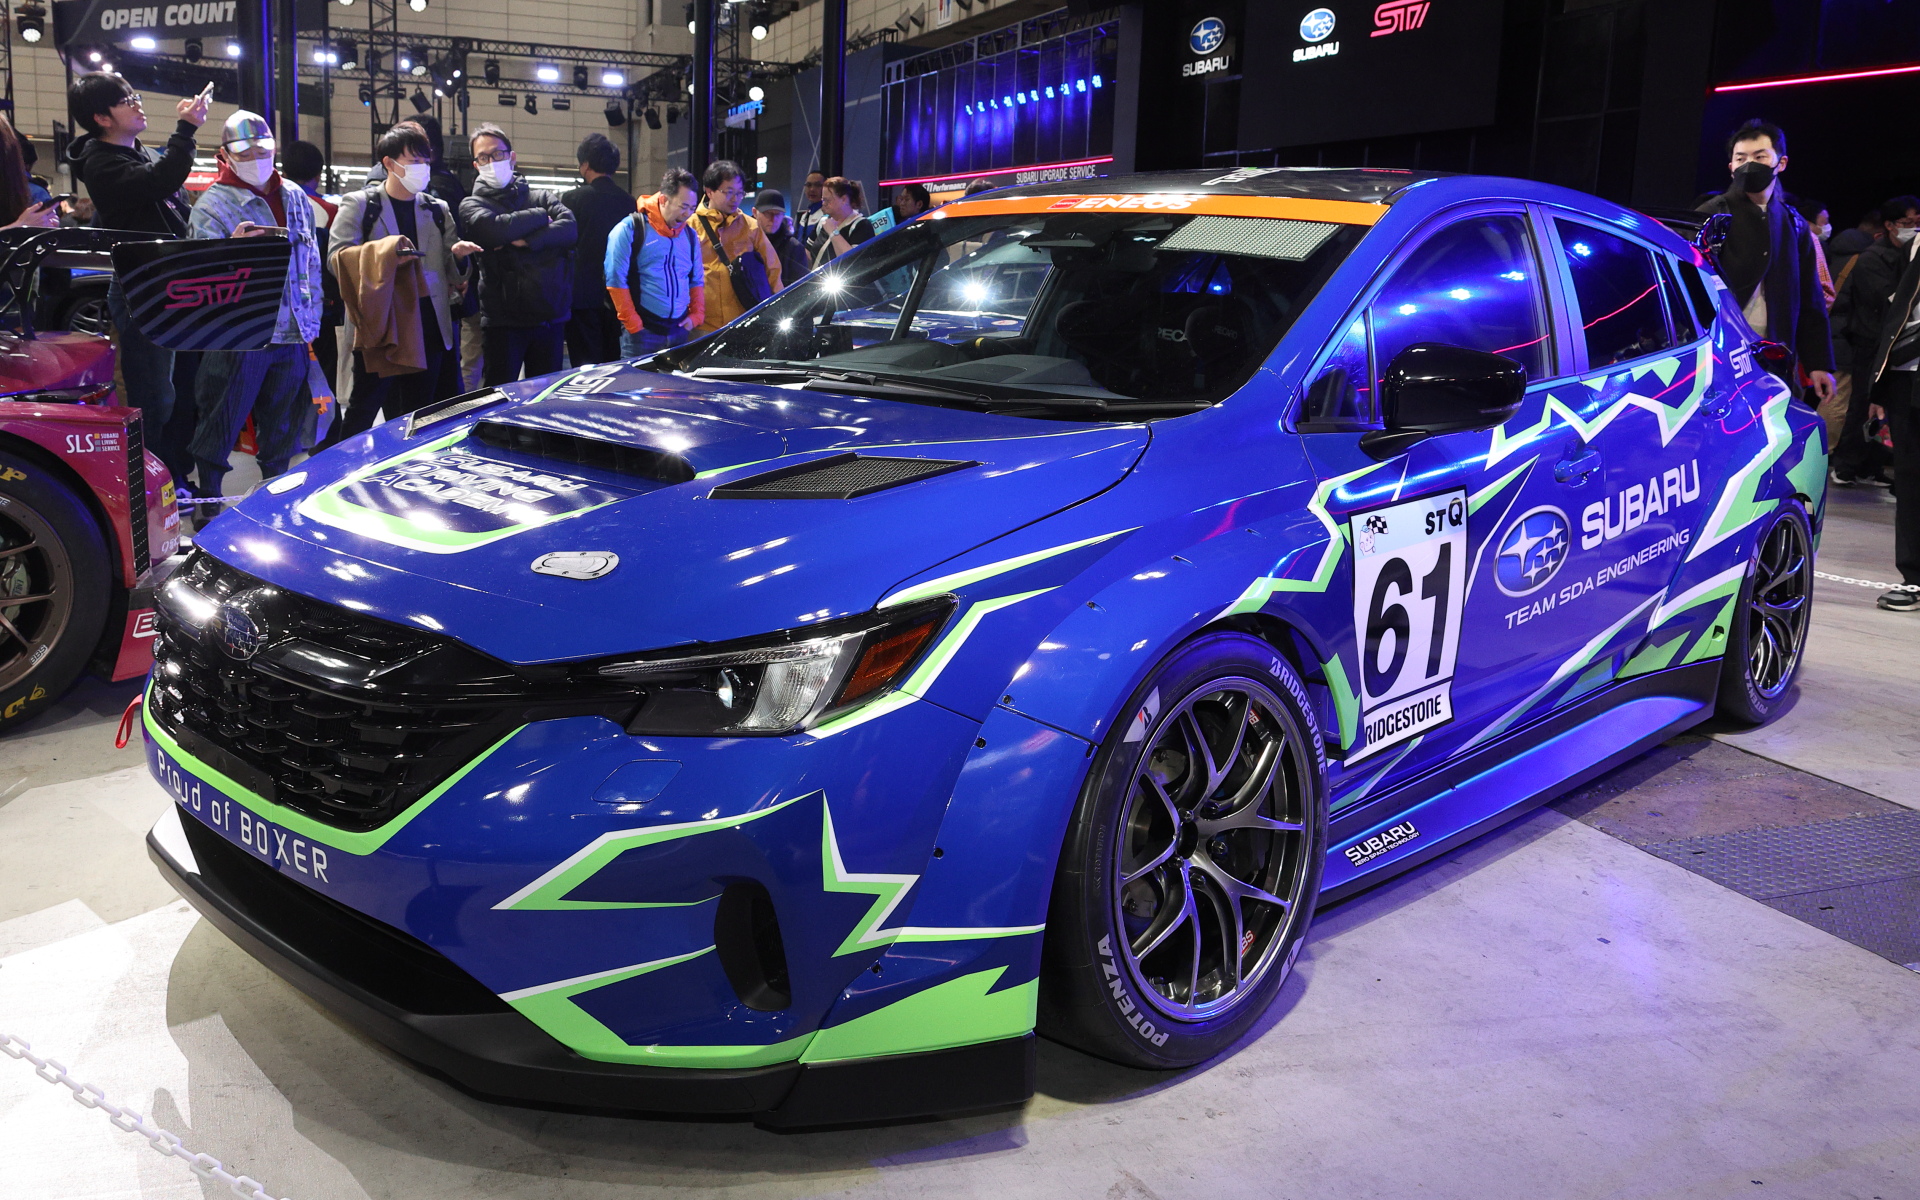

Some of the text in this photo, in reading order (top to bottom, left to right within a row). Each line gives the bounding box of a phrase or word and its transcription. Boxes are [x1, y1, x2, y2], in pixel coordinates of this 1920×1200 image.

[101, 7, 158, 30] OPEN
[1370, 0, 1430, 37] STI
[1182, 56, 1229, 77] SUBARU
[1293, 41, 1339, 62] SUBARU
[933, 183, 966, 193] Performance
[1016, 165, 1095, 184] SUBARU UPGRADE SERVICE
[1074, 196, 1198, 209] ENEOS
[164, 267, 252, 309] STI
[66, 433, 95, 453] SLS
[394, 462, 556, 504] DRIVING
[435, 454, 589, 492] SUBARU
[1581, 459, 1700, 551] SUBARU
[1505, 528, 1690, 630] TEAM SDA ENGINEERING
[1363, 541, 1452, 698] 61
[1269, 656, 1327, 775] BRIDGESTONE
[157, 748, 329, 883] Proud of BOXER
[1344, 821, 1415, 862] SUBARU
[1354, 831, 1420, 867] AERO SPACE TECHNOLOGY
[1097, 933, 1170, 1048] POTENZA
